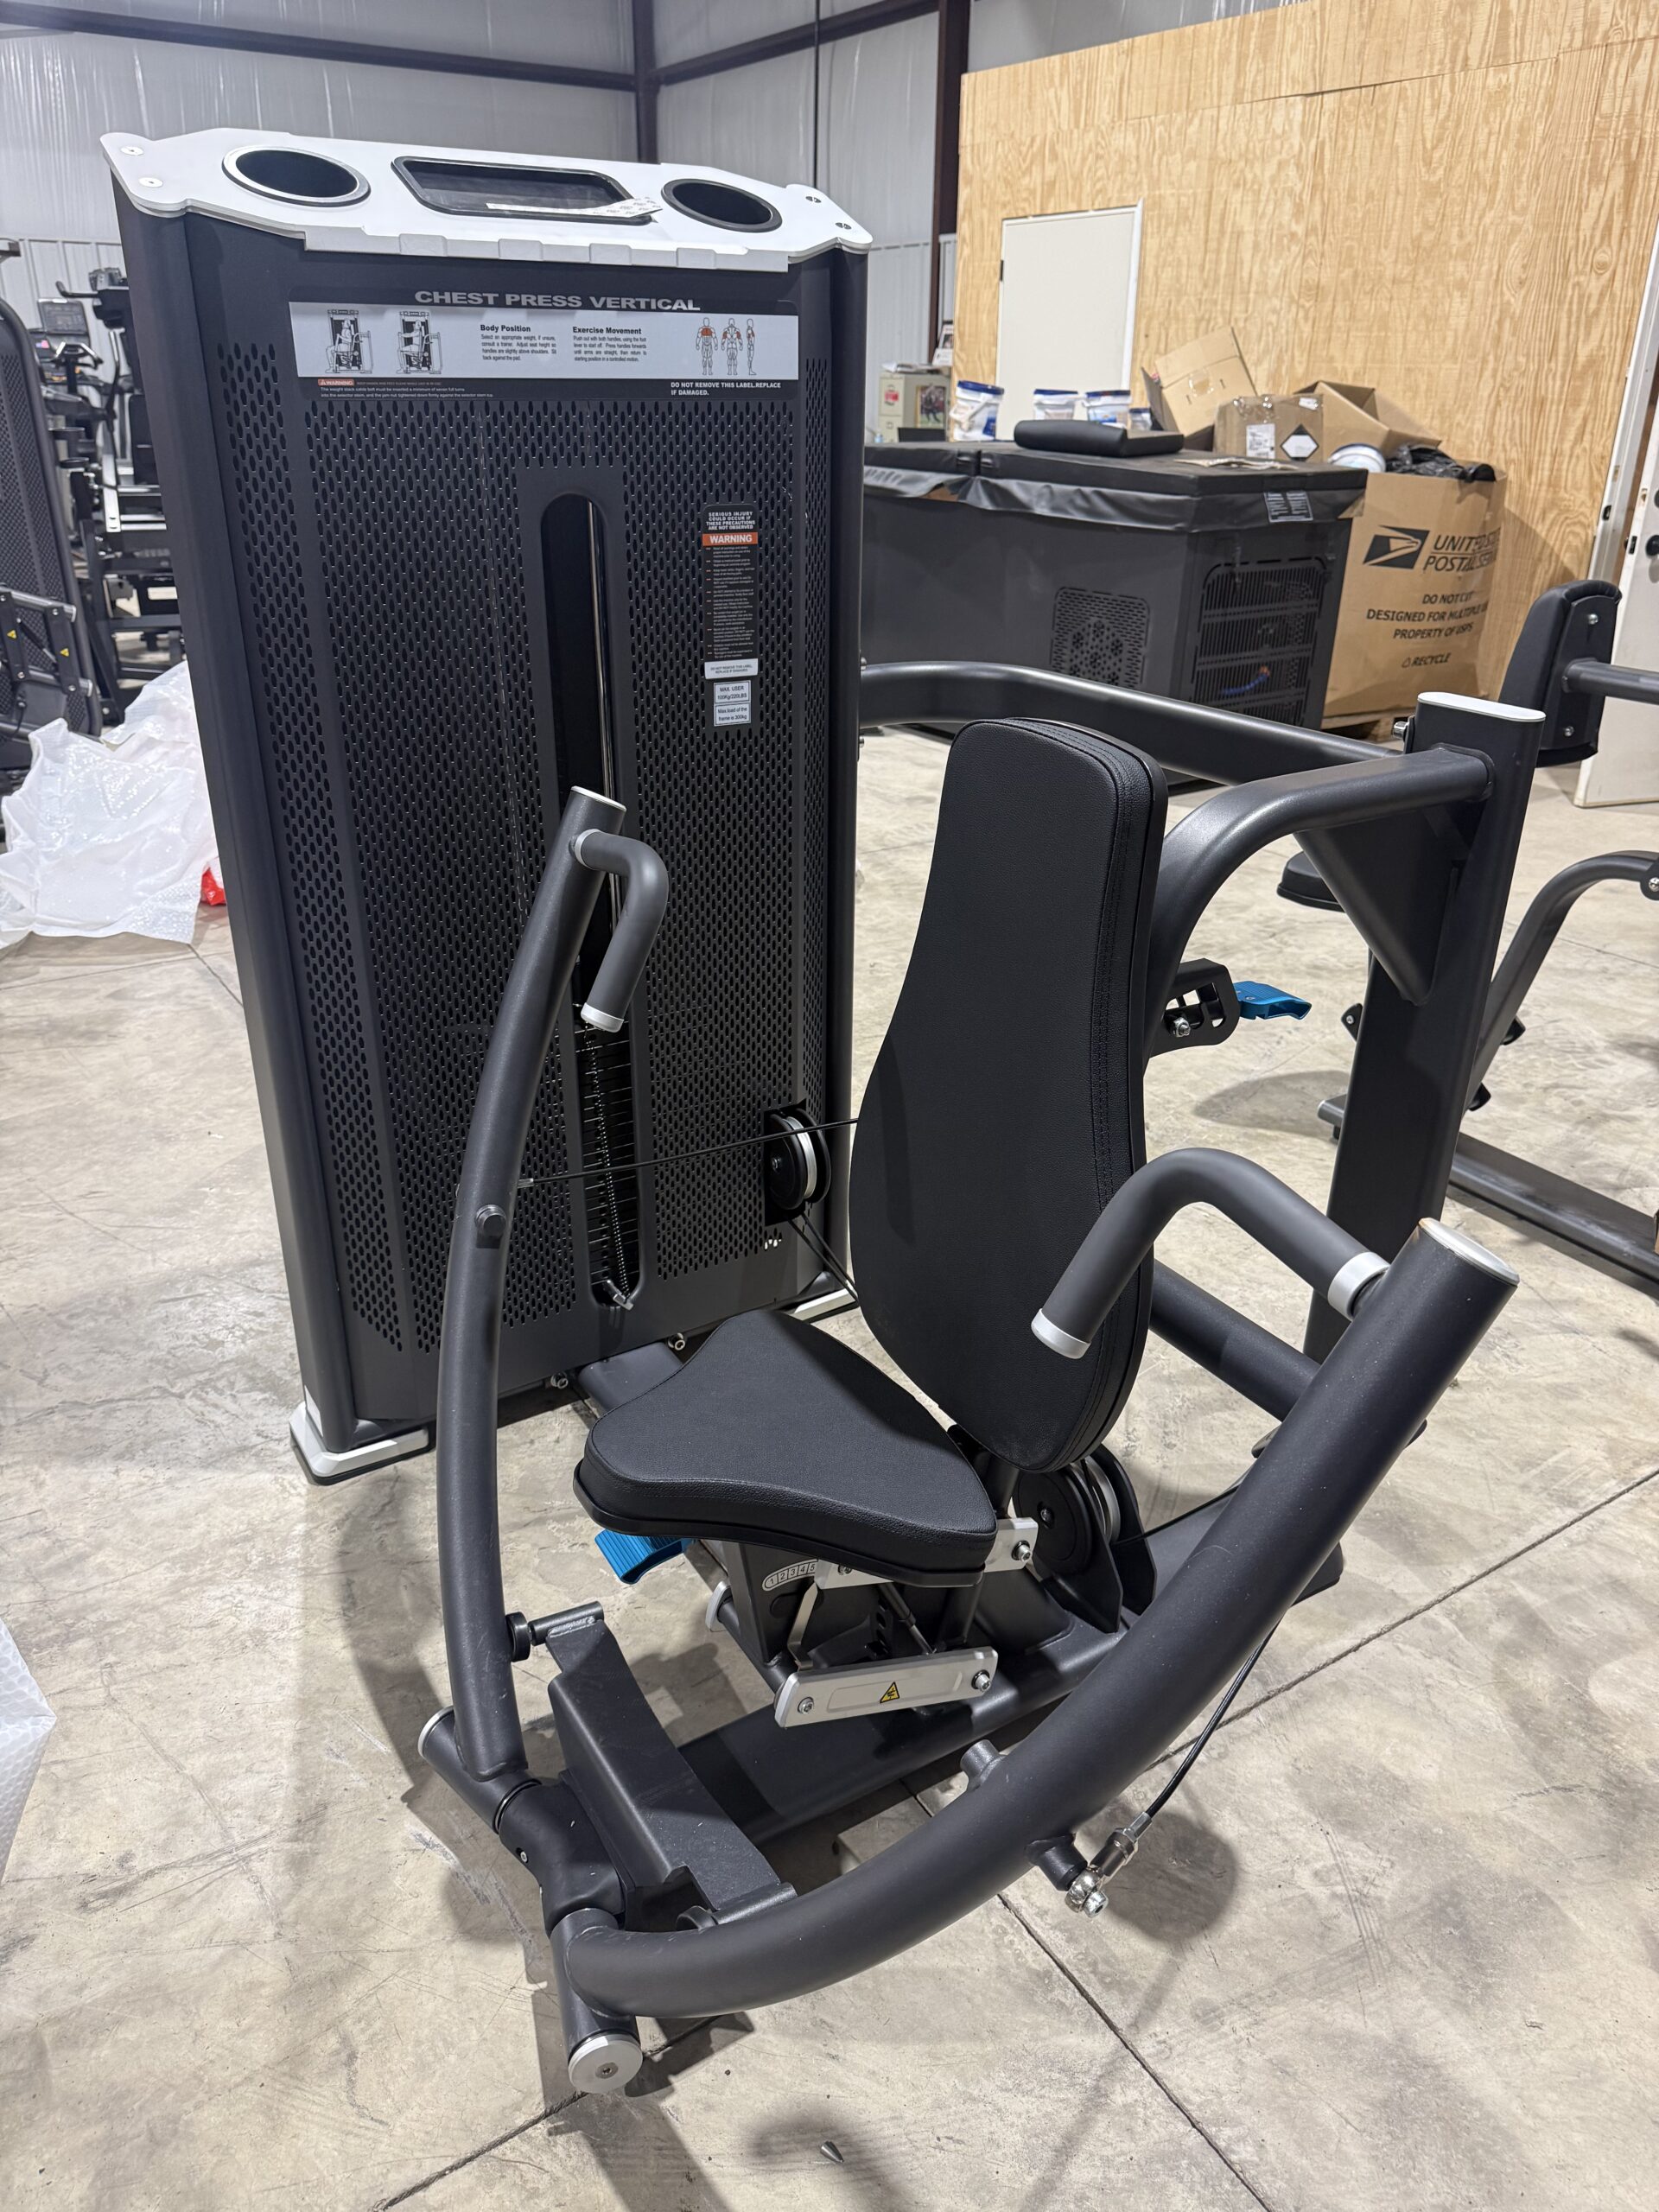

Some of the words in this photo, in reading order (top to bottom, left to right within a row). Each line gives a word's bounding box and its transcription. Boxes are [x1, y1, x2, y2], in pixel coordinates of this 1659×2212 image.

[414, 290, 499, 305] CHEST
[505, 293, 582, 308] PRESS
[589, 296, 701, 311] VERTICAL
[480, 324, 499, 333] Body
[710, 534, 752, 544] WARNING
[1422, 594, 1438, 604] DO
[1439, 594, 1459, 604] NOT
[1366, 609, 1426, 622] DESIGNED
[1427, 611, 1447, 622] FOR
[1393, 628, 1443, 639] PROPERTY
[1444, 626, 1456, 637] OF
[1411, 652, 1452, 667] RECYCLE
